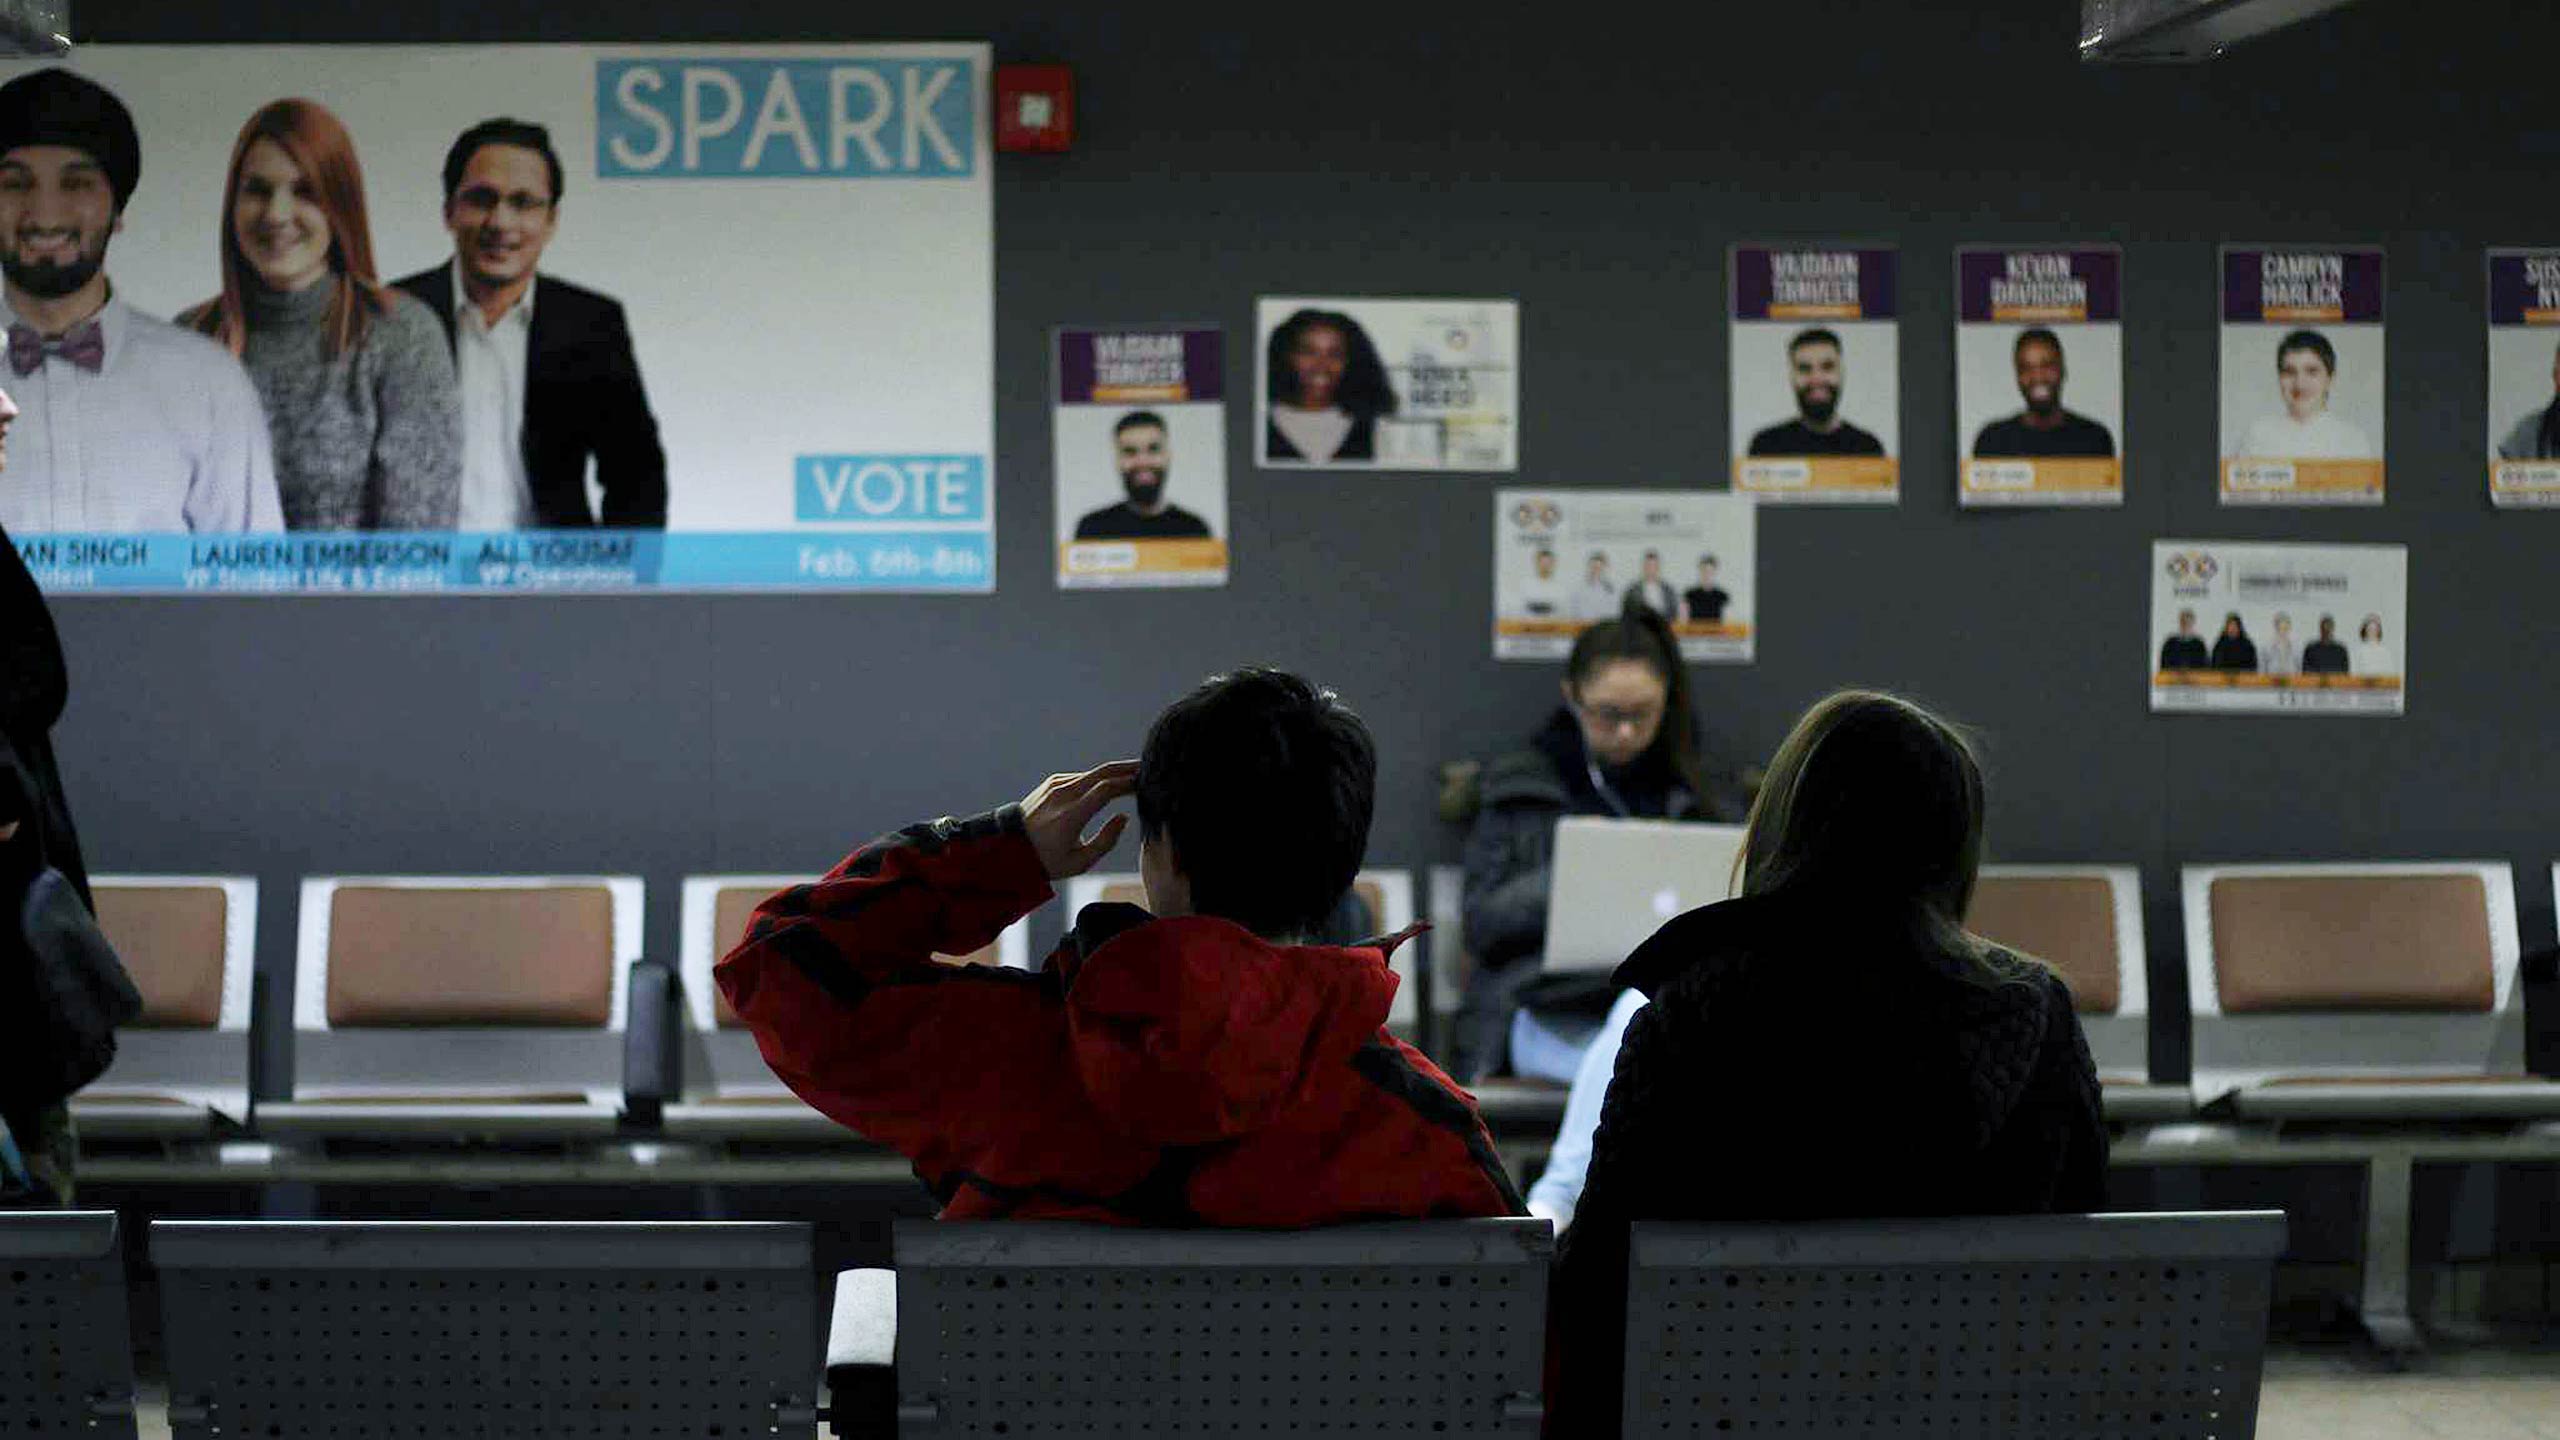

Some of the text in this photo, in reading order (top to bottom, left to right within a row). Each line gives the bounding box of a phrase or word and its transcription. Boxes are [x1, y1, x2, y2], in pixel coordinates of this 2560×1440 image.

[609, 66, 964, 171] SPARK
[812, 463, 968, 515] VOTE
[66, 539, 148, 566] SINGH
[191, 541, 450, 568] LAUREN EMBERSON
